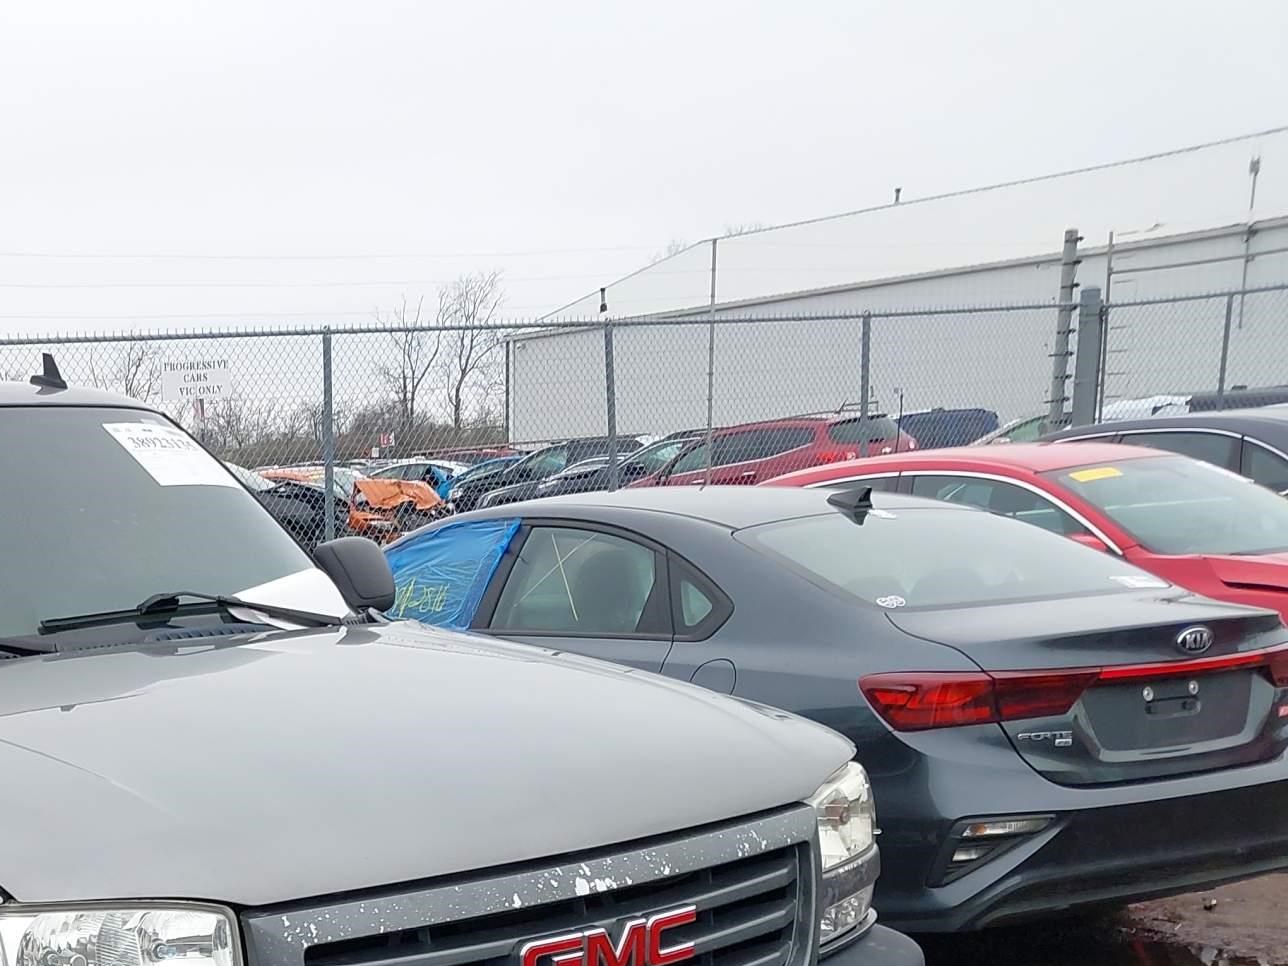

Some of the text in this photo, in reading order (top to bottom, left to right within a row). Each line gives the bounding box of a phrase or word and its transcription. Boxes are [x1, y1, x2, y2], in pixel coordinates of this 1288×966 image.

[164, 360, 229, 371] PROGRESSIVE
[183, 372, 208, 383] CARS
[198, 384, 223, 395] ONLY
[1185, 632, 1210, 650] KIA
